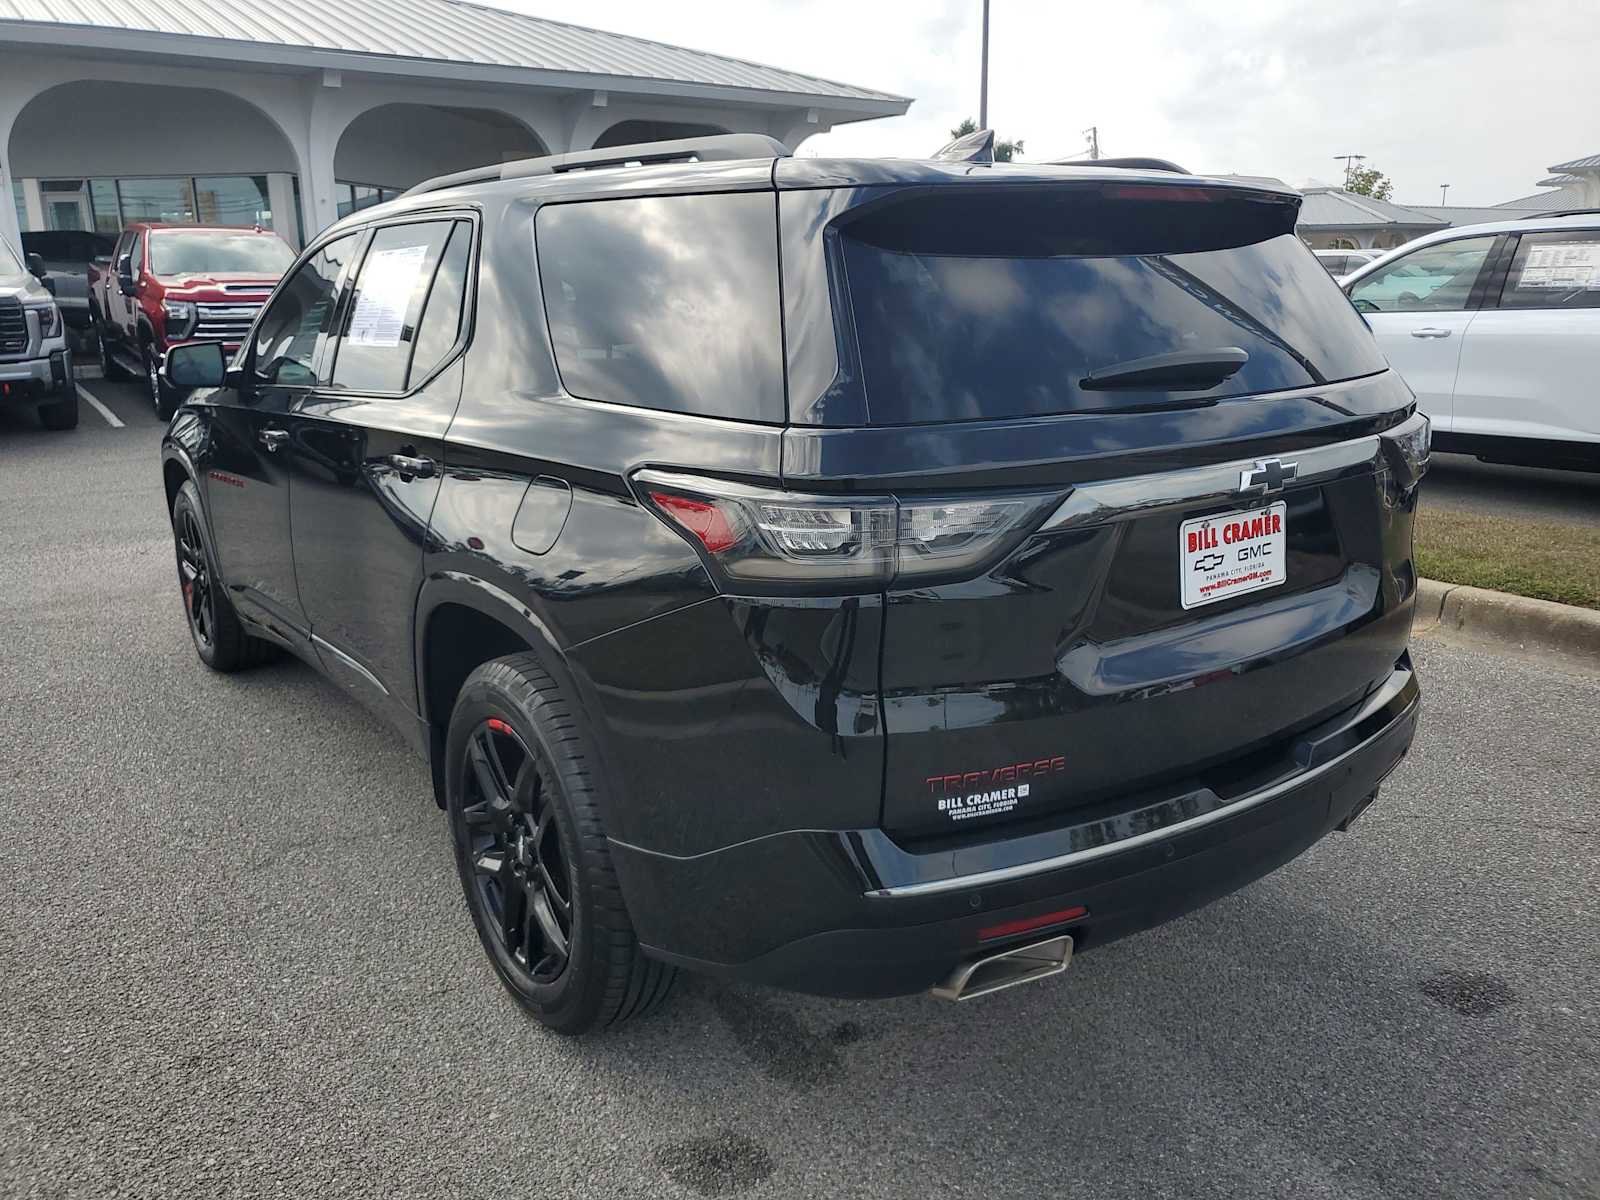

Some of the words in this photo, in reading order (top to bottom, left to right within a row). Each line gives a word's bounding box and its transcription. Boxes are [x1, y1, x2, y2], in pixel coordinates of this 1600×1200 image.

[1188, 528, 1218, 553] BILL
[1223, 514, 1281, 545] CRAMER
[1238, 543, 1272, 561] GMC
[926, 756, 1065, 793] TRAVERSE
[938, 797, 963, 811] BILL
[967, 788, 1016, 806] CRAMER
[948, 805, 977, 816] PANAMA
[992, 798, 1018, 809] FLORIDA
